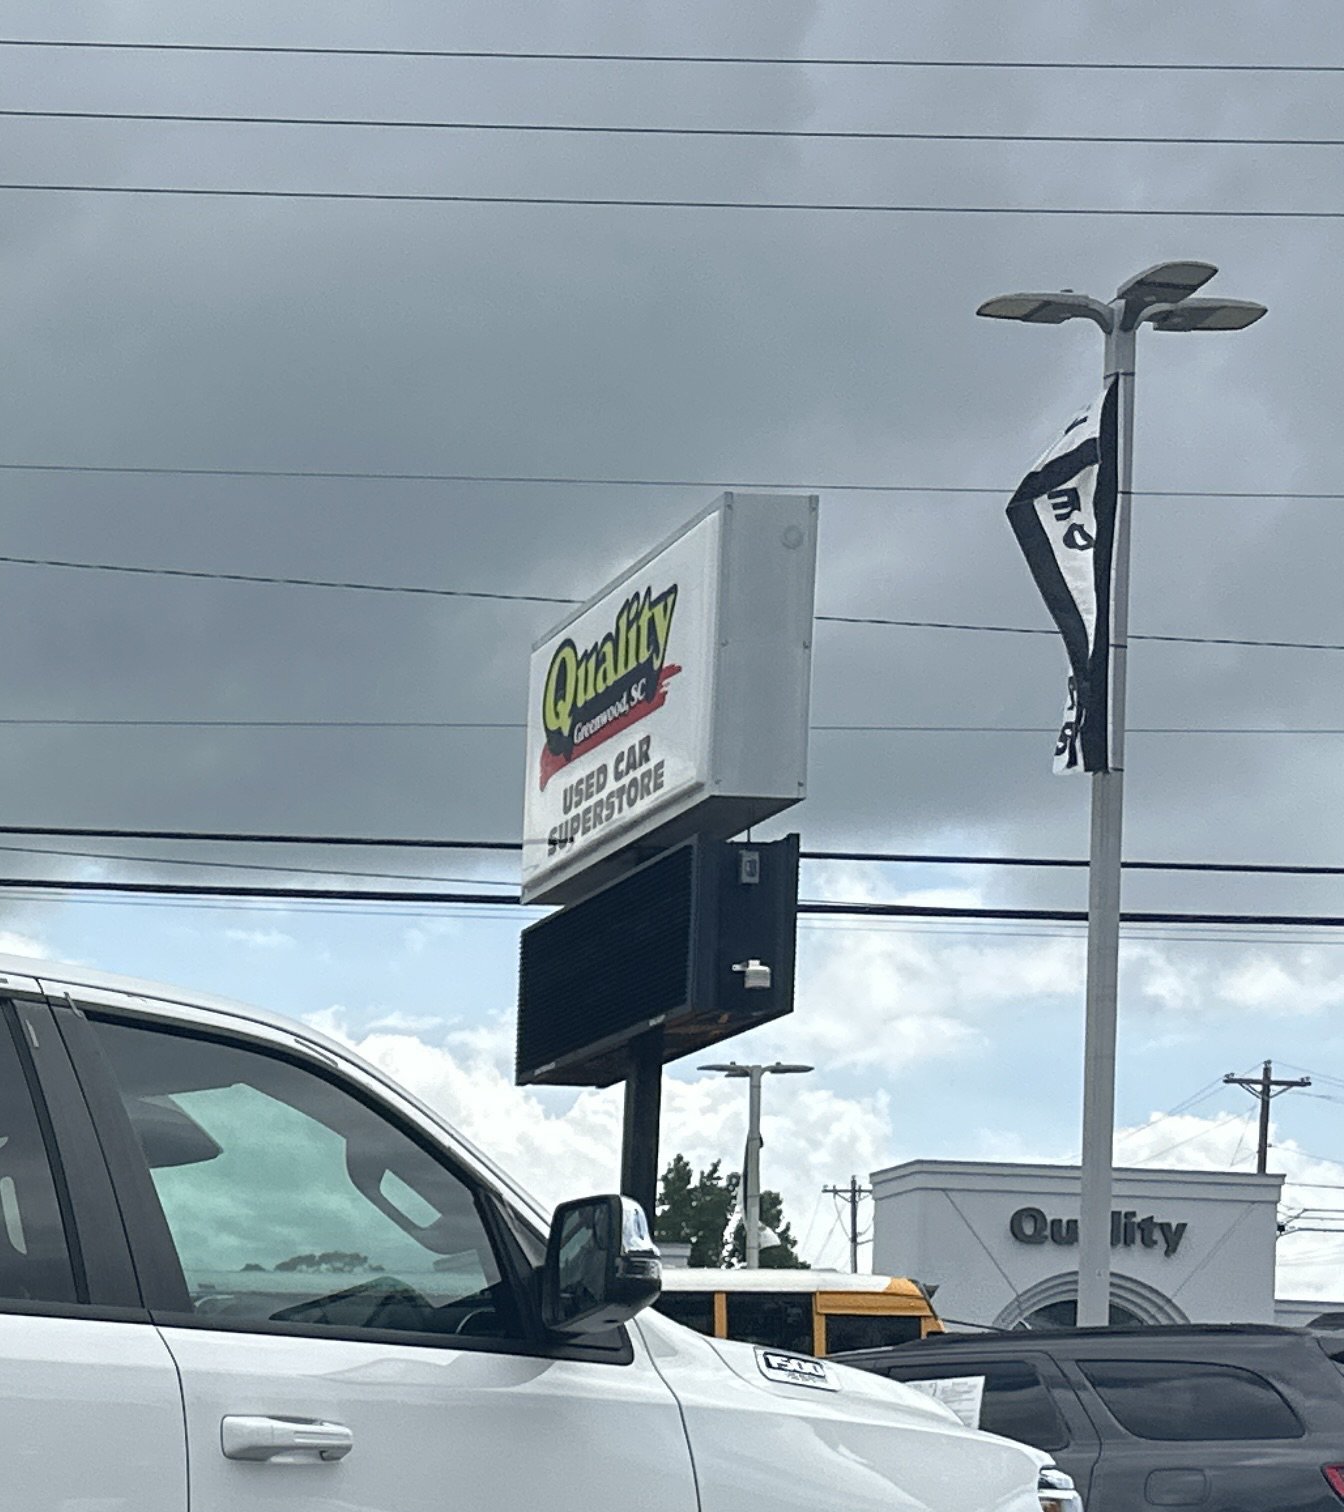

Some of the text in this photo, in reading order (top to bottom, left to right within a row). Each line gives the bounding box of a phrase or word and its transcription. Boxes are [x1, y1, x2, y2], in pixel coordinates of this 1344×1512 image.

[543, 584, 678, 739] Quality
[573, 677, 647, 745] Greenwood, SC
[547, 759, 665, 857] SUPERSTORE
[562, 734, 651, 815] USED CAR
[1010, 1206, 1188, 1258] Qulity
